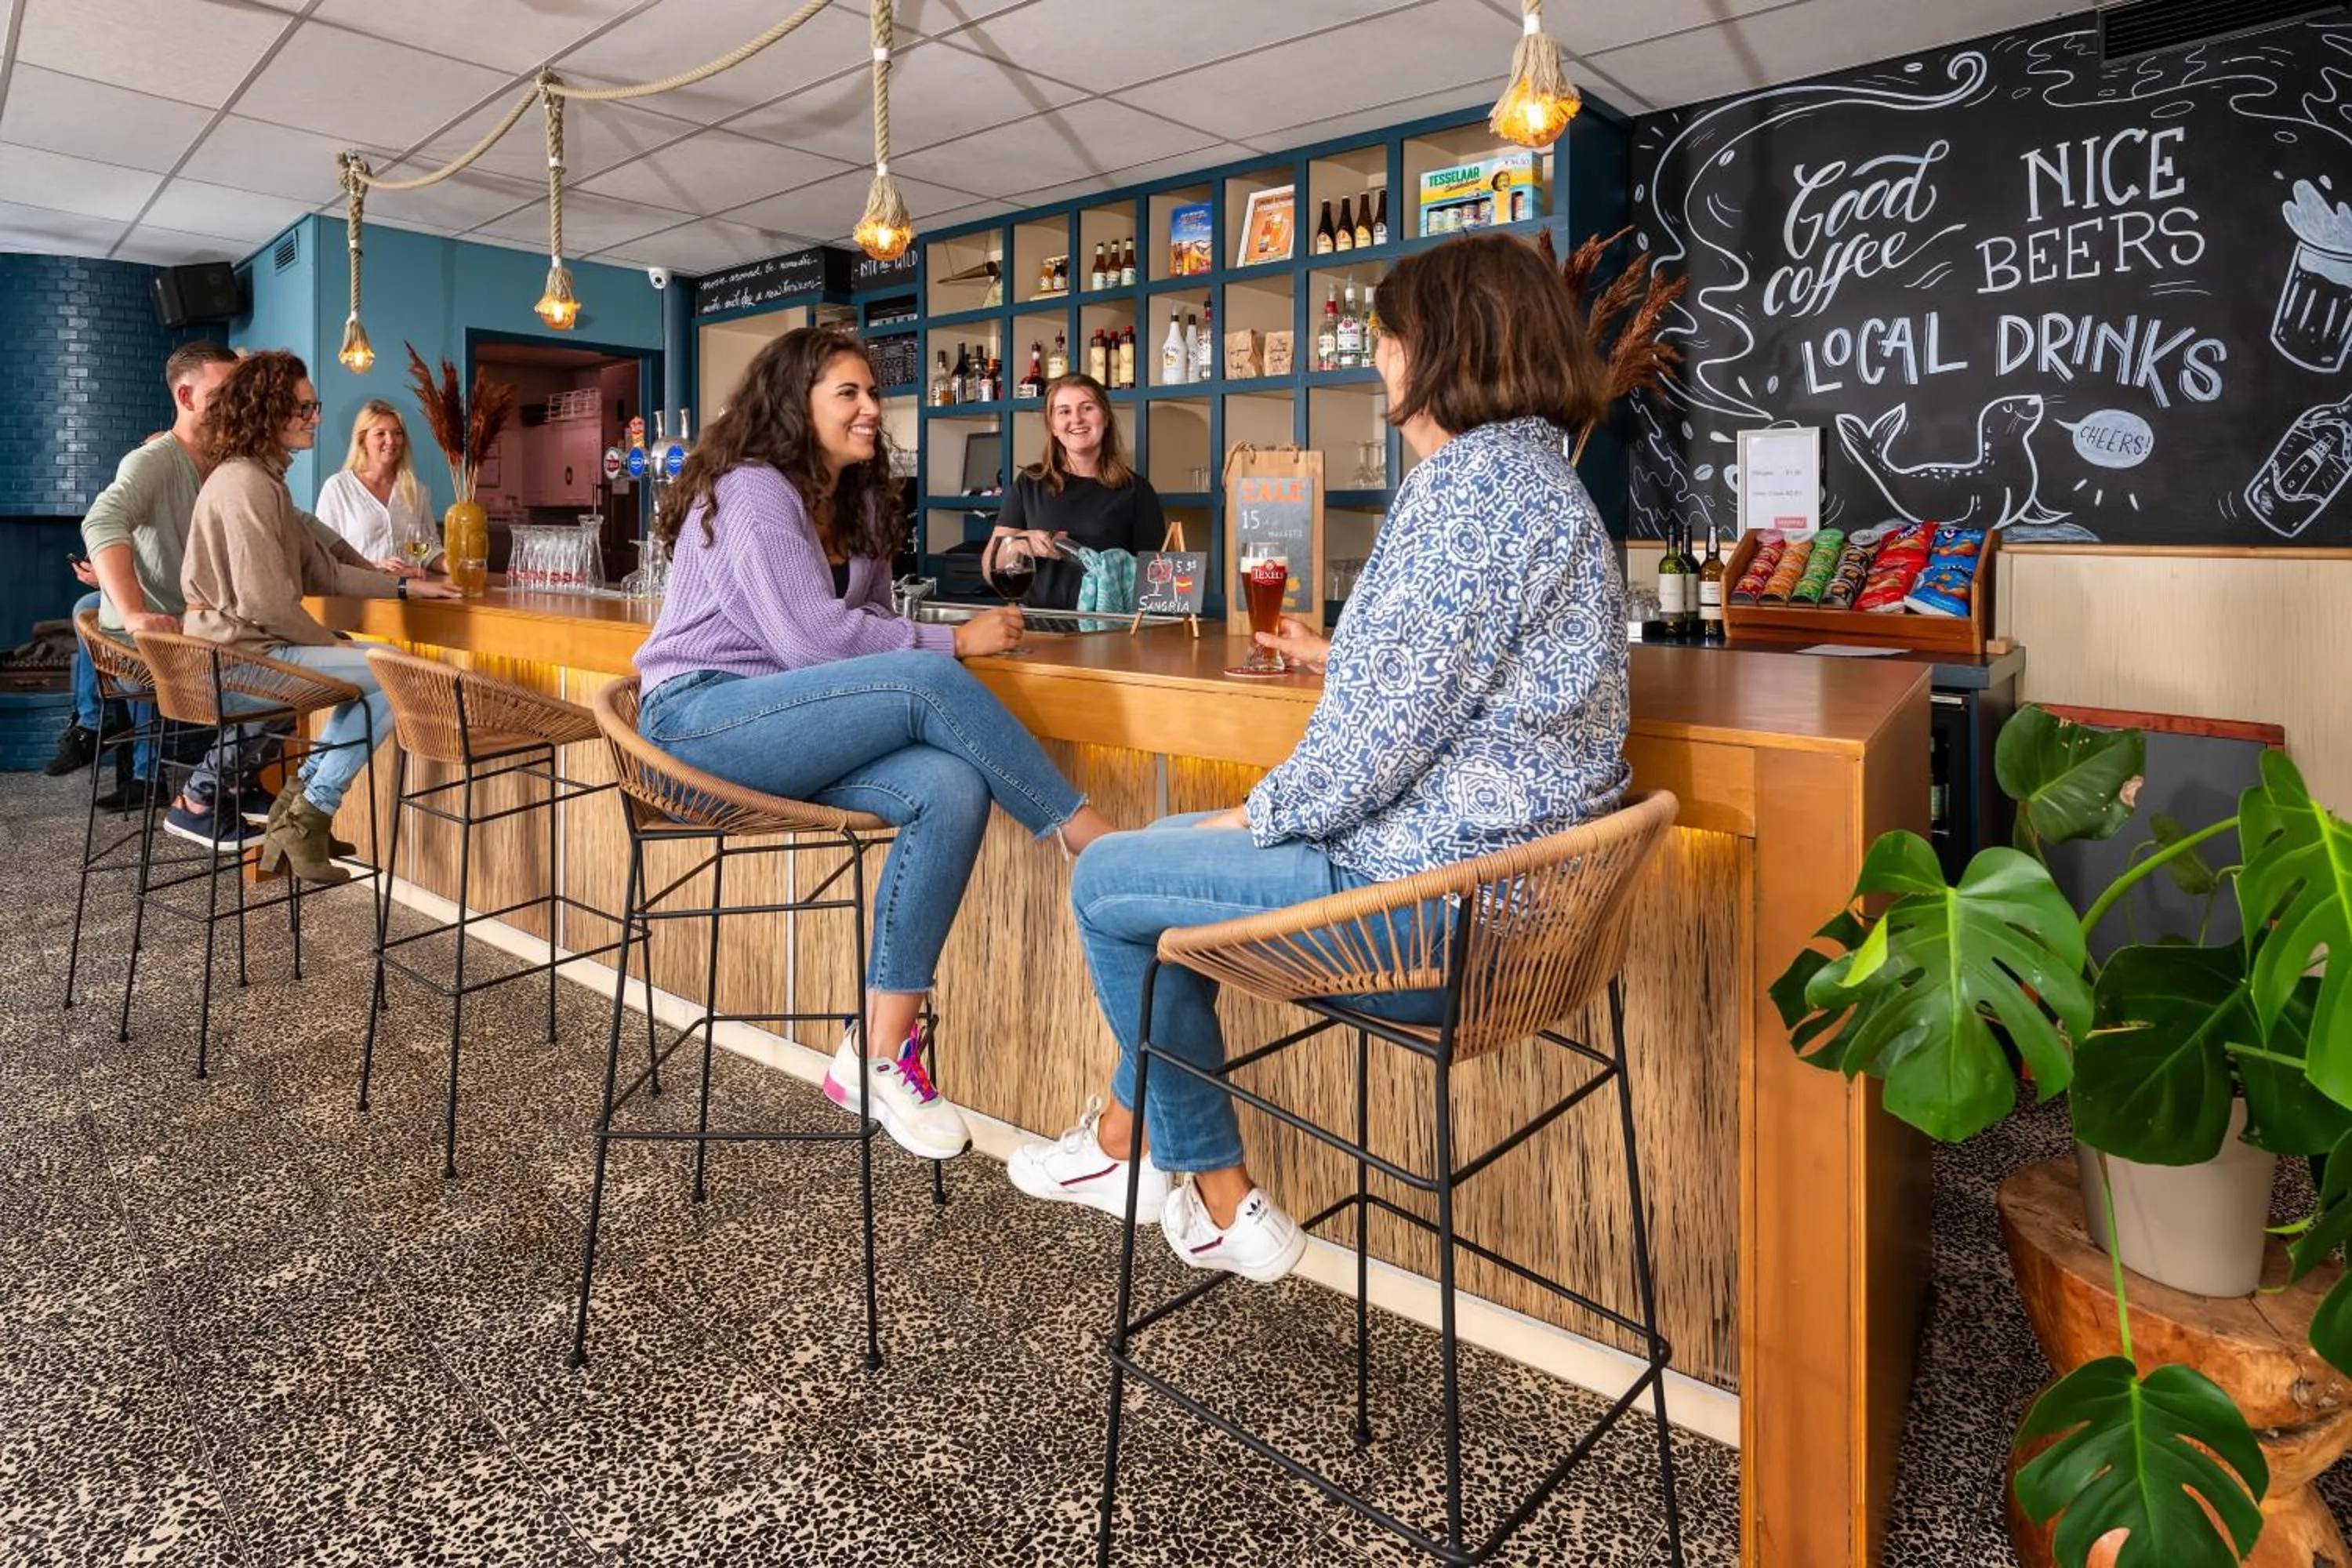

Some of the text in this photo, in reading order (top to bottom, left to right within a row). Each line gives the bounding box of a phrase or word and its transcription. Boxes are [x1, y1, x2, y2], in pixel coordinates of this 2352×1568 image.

[1429, 166, 1480, 187] TESSELAAR
[1784, 140, 1950, 260] Good
[2020, 126, 2185, 222] NICE
[1763, 224, 1967, 318] coffee
[1975, 207, 2205, 293] BEERS
[1802, 312, 2227, 408] LOCAL DRINKS
[2080, 426, 2151, 456] CHEERS!
[1242, 510, 1260, 529] 15
